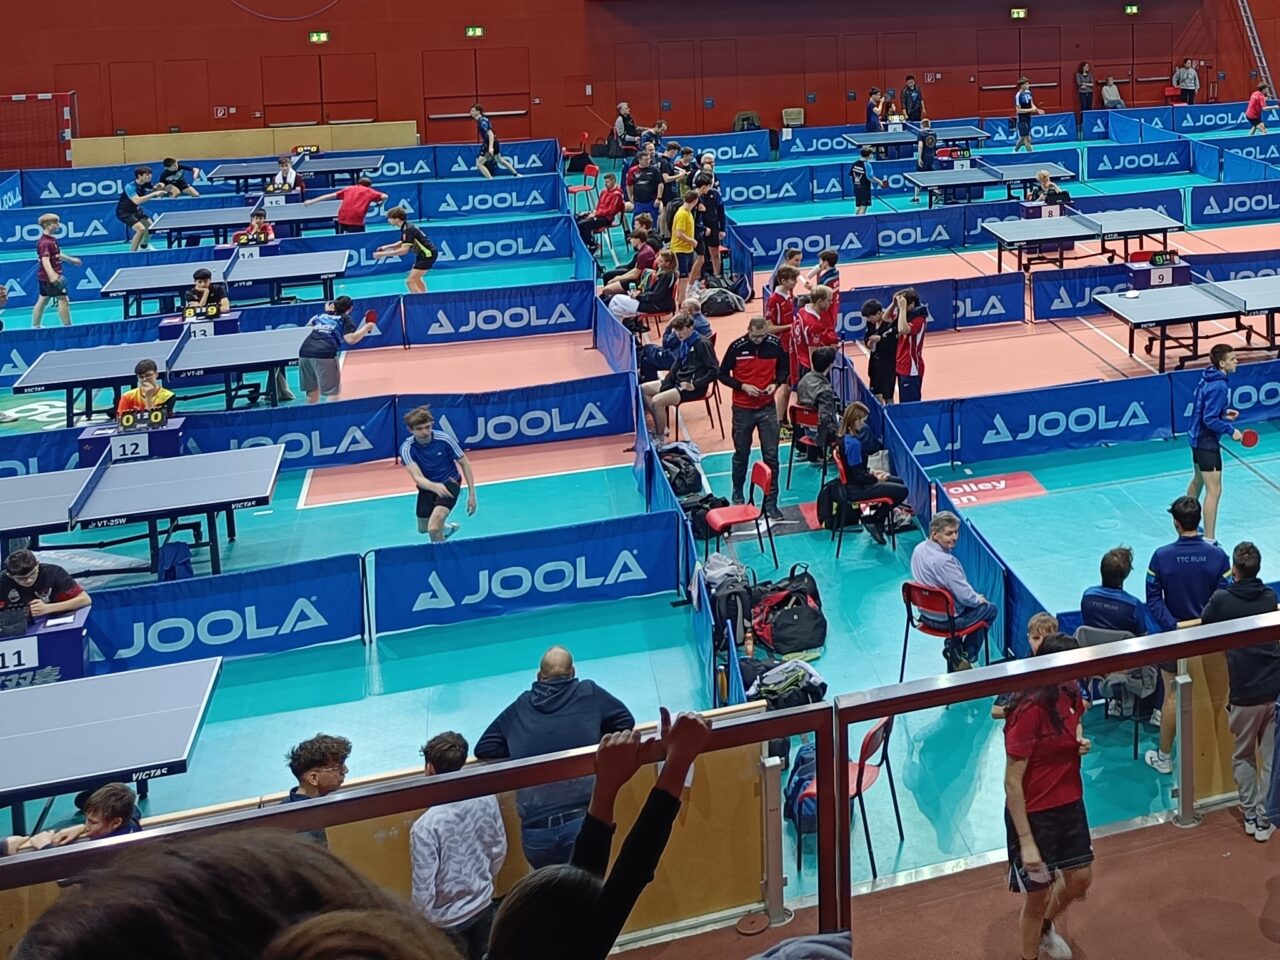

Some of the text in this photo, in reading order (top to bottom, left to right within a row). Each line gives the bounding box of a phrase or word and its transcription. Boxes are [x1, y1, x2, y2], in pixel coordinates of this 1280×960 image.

[1196, 111, 1248, 127] JOOLA
[1007, 123, 1068, 141] JOLA
[806, 138, 857, 152] JOOL
[1230, 144, 1280, 159] OOLA
[469, 153, 543, 172] JOLA
[1114, 152, 1180, 170] JOOLA
[63, 180, 125, 198] JOOL
[722, 182, 797, 202] JOOLA
[461, 190, 545, 211] JOOLA
[239, 235, 248, 243] 2
[768, 232, 863, 257] JOOLA
[878, 224, 951, 247] OOLA
[458, 235, 556, 260] JOOLA
[1156, 254, 1164, 265] 9
[1157, 273, 1165, 284] 9
[185, 305, 217, 317] 8 9
[459, 303, 575, 333] JOOLA
[122, 412, 134, 427] 0
[150, 411, 162, 425] 0
[464, 402, 609, 443] JOOLA
[1016, 400, 1150, 440] JOOLA
[119, 443, 141, 456] 12
[949, 478, 1007, 496] olley
[231, 501, 257, 510] VICTAS
[952, 494, 978, 507] en
[97, 517, 127, 527] VT-25W
[461, 549, 648, 604] JOOLA
[113, 597, 328, 660] JOOLA
[0, 649, 26, 669] 11
[132, 767, 168, 781] VICTAS
